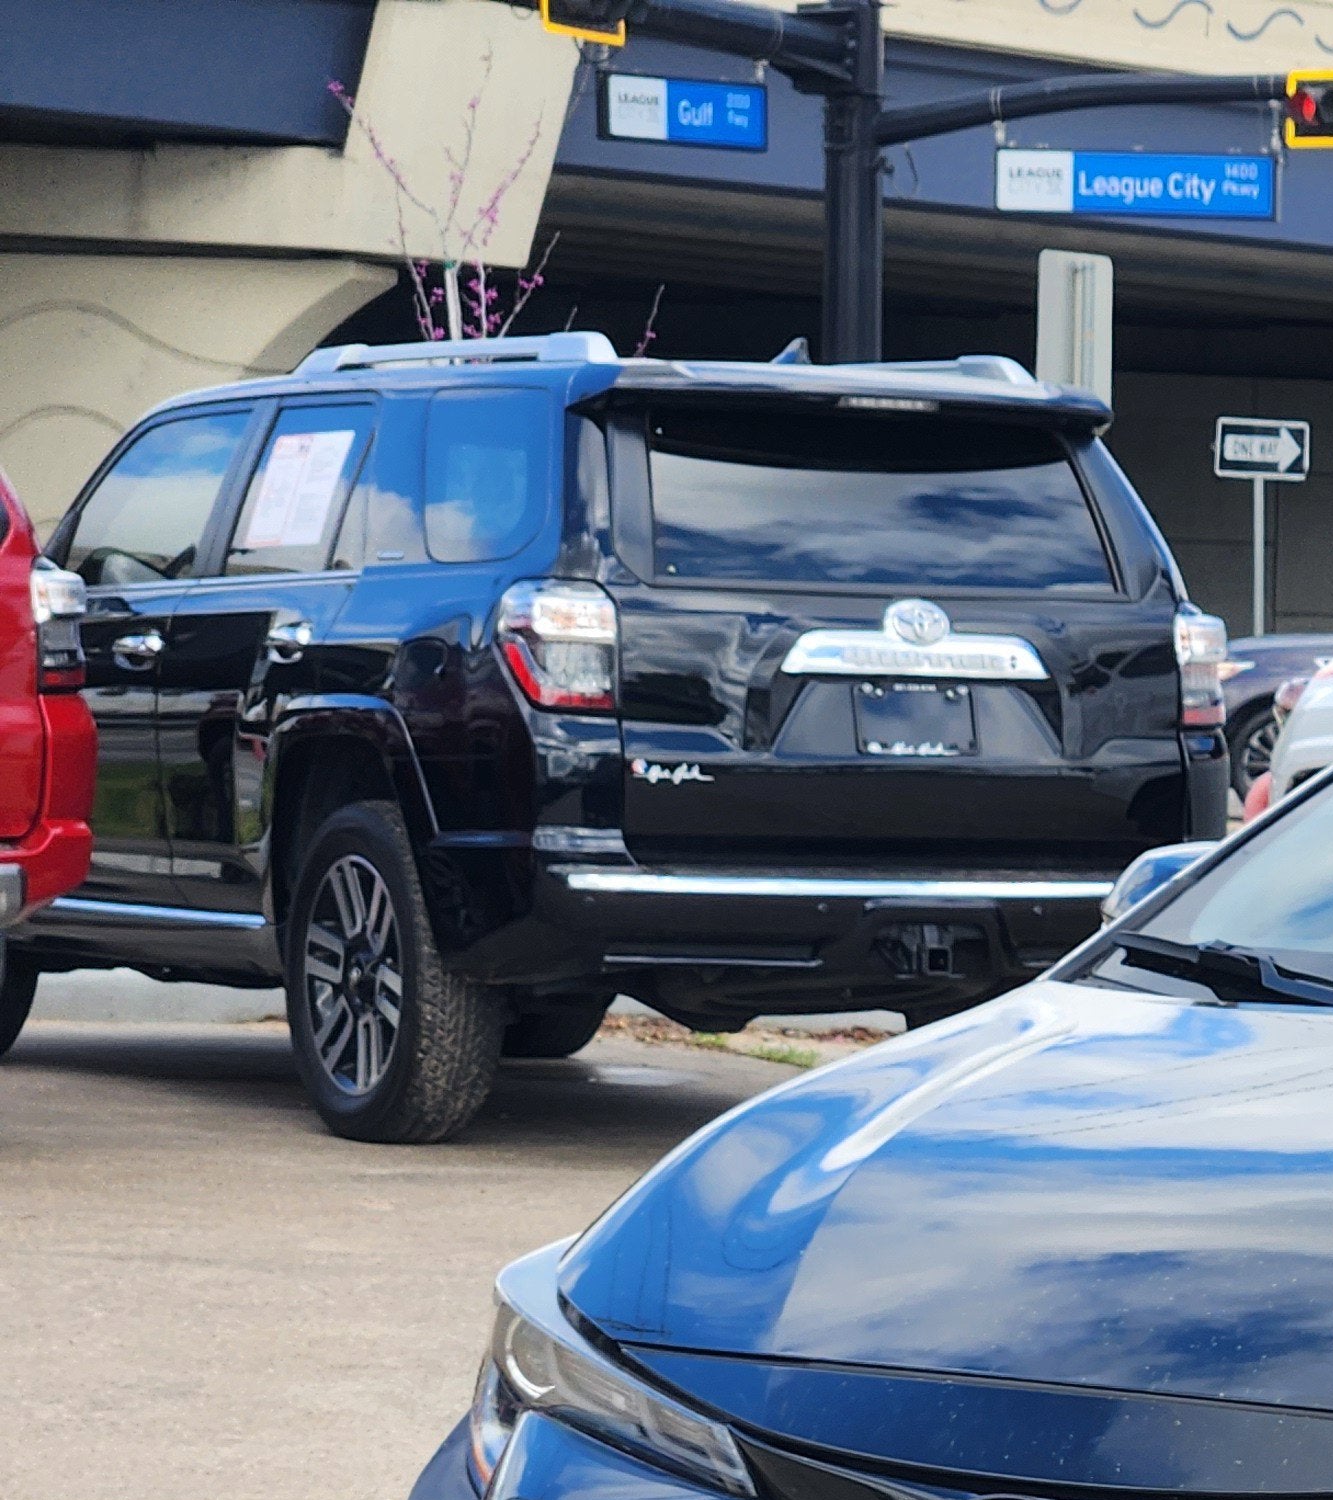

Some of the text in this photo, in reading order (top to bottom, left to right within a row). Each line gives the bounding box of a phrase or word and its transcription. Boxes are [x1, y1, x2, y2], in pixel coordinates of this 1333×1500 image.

[677, 98, 714, 127] Gulf
[1078, 170, 1164, 205] League
[1167, 171, 1216, 206] City
